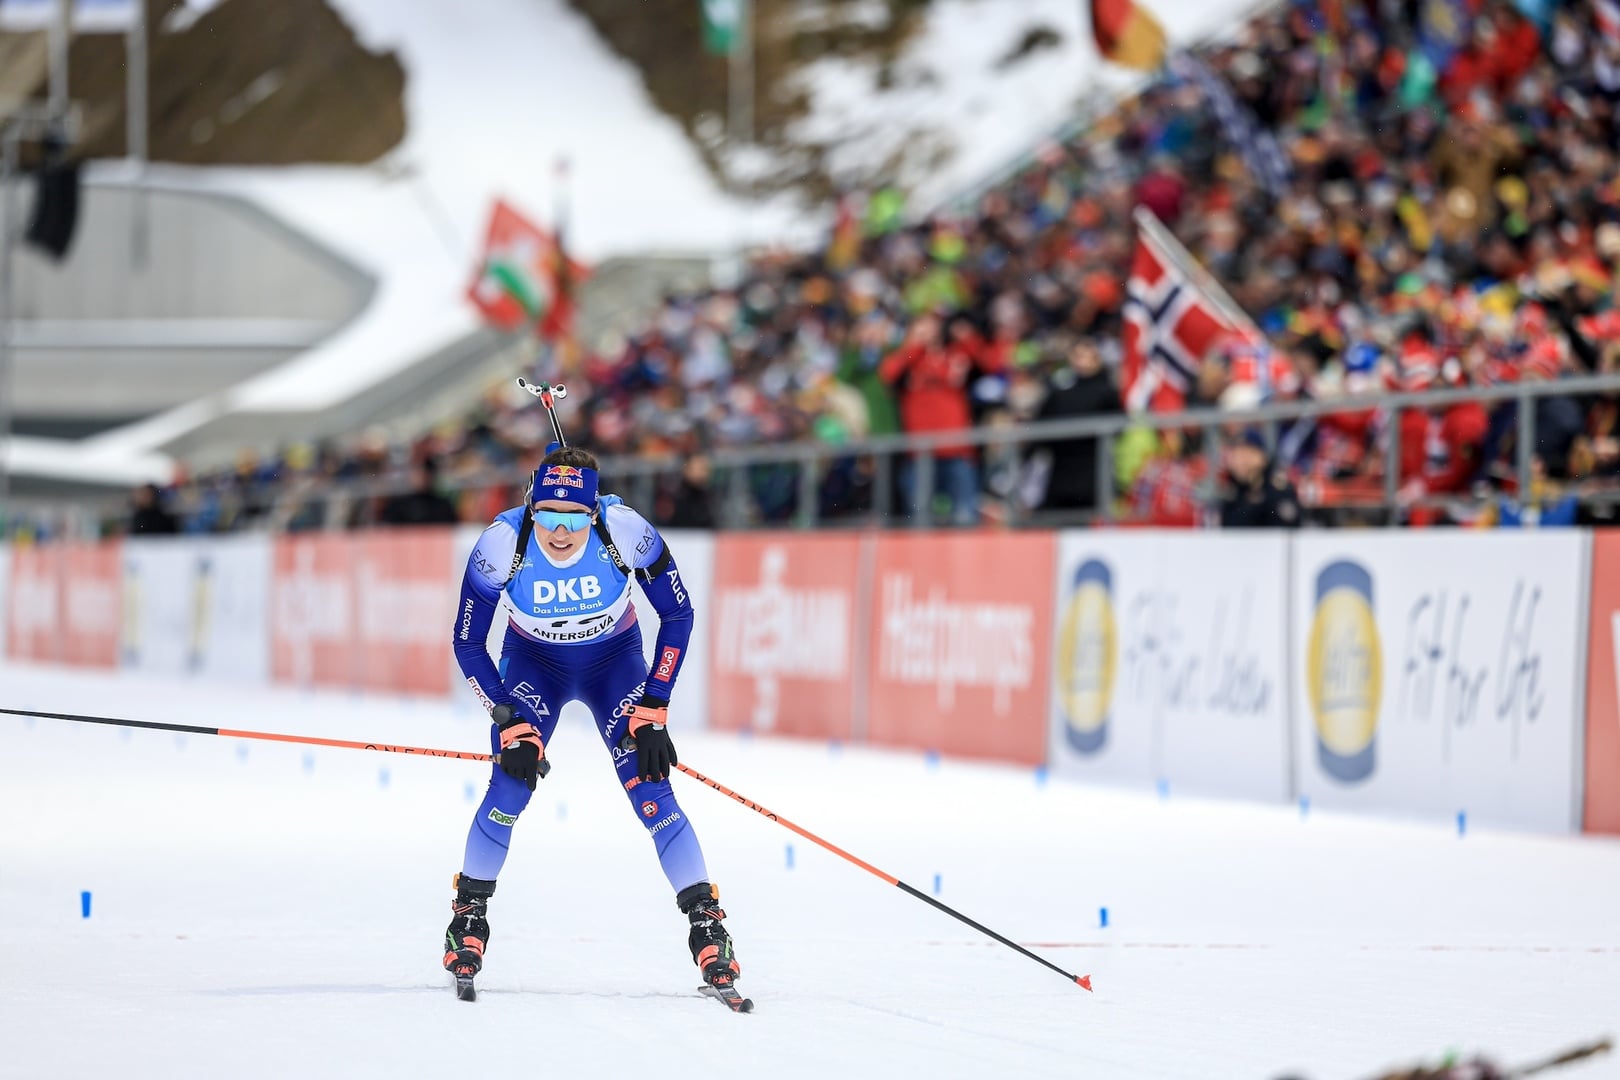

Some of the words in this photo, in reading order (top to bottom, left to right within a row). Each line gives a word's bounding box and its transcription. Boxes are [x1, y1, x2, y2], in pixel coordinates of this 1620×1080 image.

[542, 476, 562, 486] Red
[563, 477, 584, 489] Bull
[472, 549, 497, 575] EA7
[606, 543, 625, 568] FIOCCHI
[533, 575, 602, 604] DKB
[533, 606, 552, 615] Das
[554, 606, 577, 614] kann
[580, 600, 604, 611] Bank
[533, 615, 614, 641] ANTERSELVA
[657, 650, 675, 678] enel
[513, 681, 551, 716] EA7
